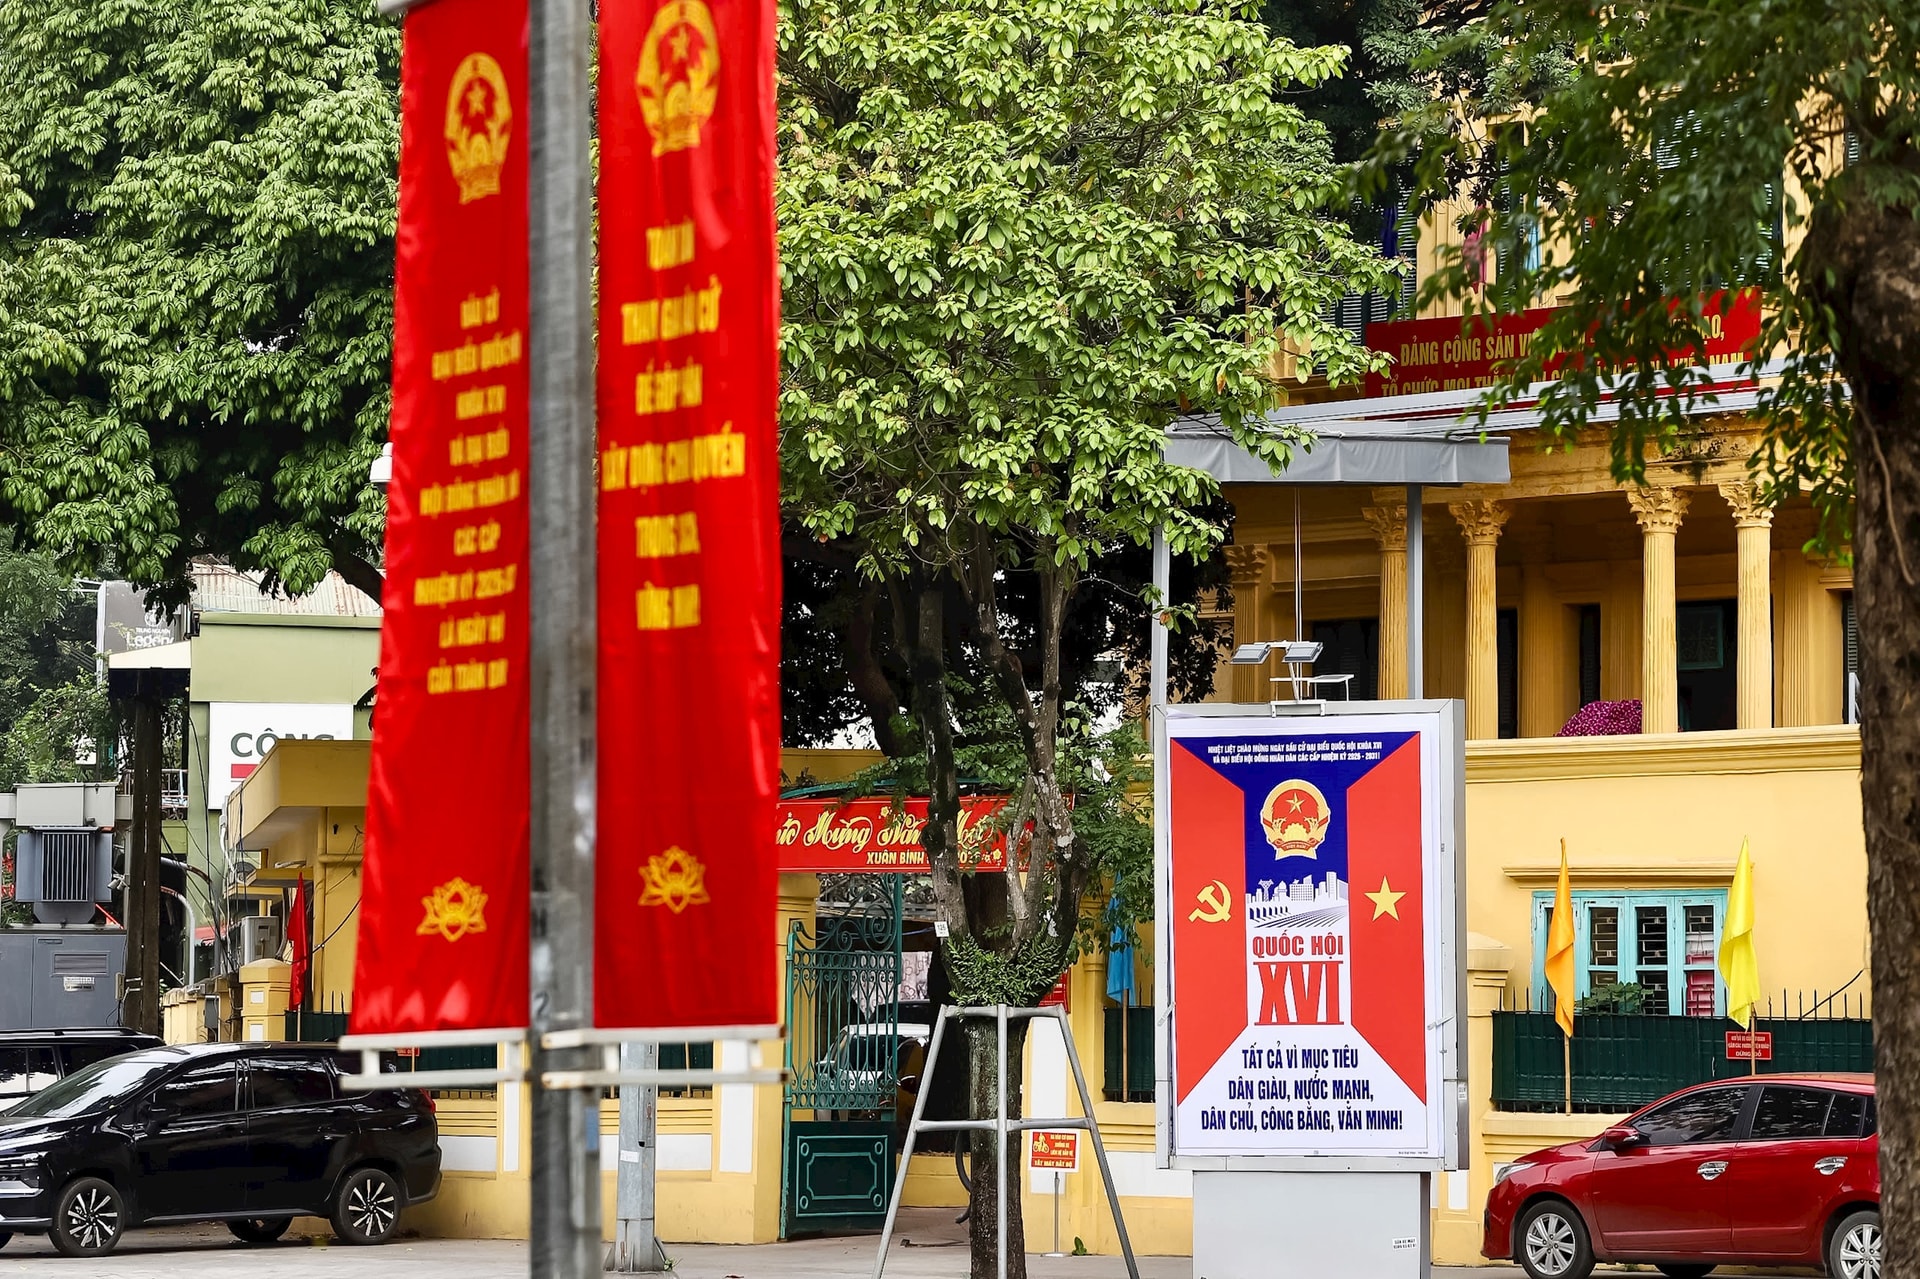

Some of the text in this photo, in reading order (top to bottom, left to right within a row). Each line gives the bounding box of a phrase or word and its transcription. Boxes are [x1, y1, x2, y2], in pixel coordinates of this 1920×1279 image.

[1401, 335, 1439, 367] ĐẢNG
[1443, 335, 1480, 369] CỘNG
[1486, 328, 1514, 361] SẢN
[231, 728, 334, 757] CÔ
[1224, 744, 1236, 754] LIỆT
[1237, 744, 1251, 753] CHÀO
[1270, 743, 1284, 752] NGÀY
[1331, 740, 1345, 751] QUỐC
[1298, 753, 1308, 761] CÁC
[803, 811, 873, 853] Mừng
[867, 850, 896, 864] XUÂN
[900, 849, 924, 864] BÍNH
[1253, 930, 1343, 959] QUỐC HỘI
[1253, 961, 1344, 1025] XVI
[1242, 1040, 1358, 1073] TẤT CẢ VÌ MỤC TIÊU
[1229, 1074, 1374, 1104] DÂN GIÀU, NƯỚC MẠNH,
[1201, 1101, 1402, 1133] DÂN CHỦ, CÔNG BẰNG, VĂN MINH!
